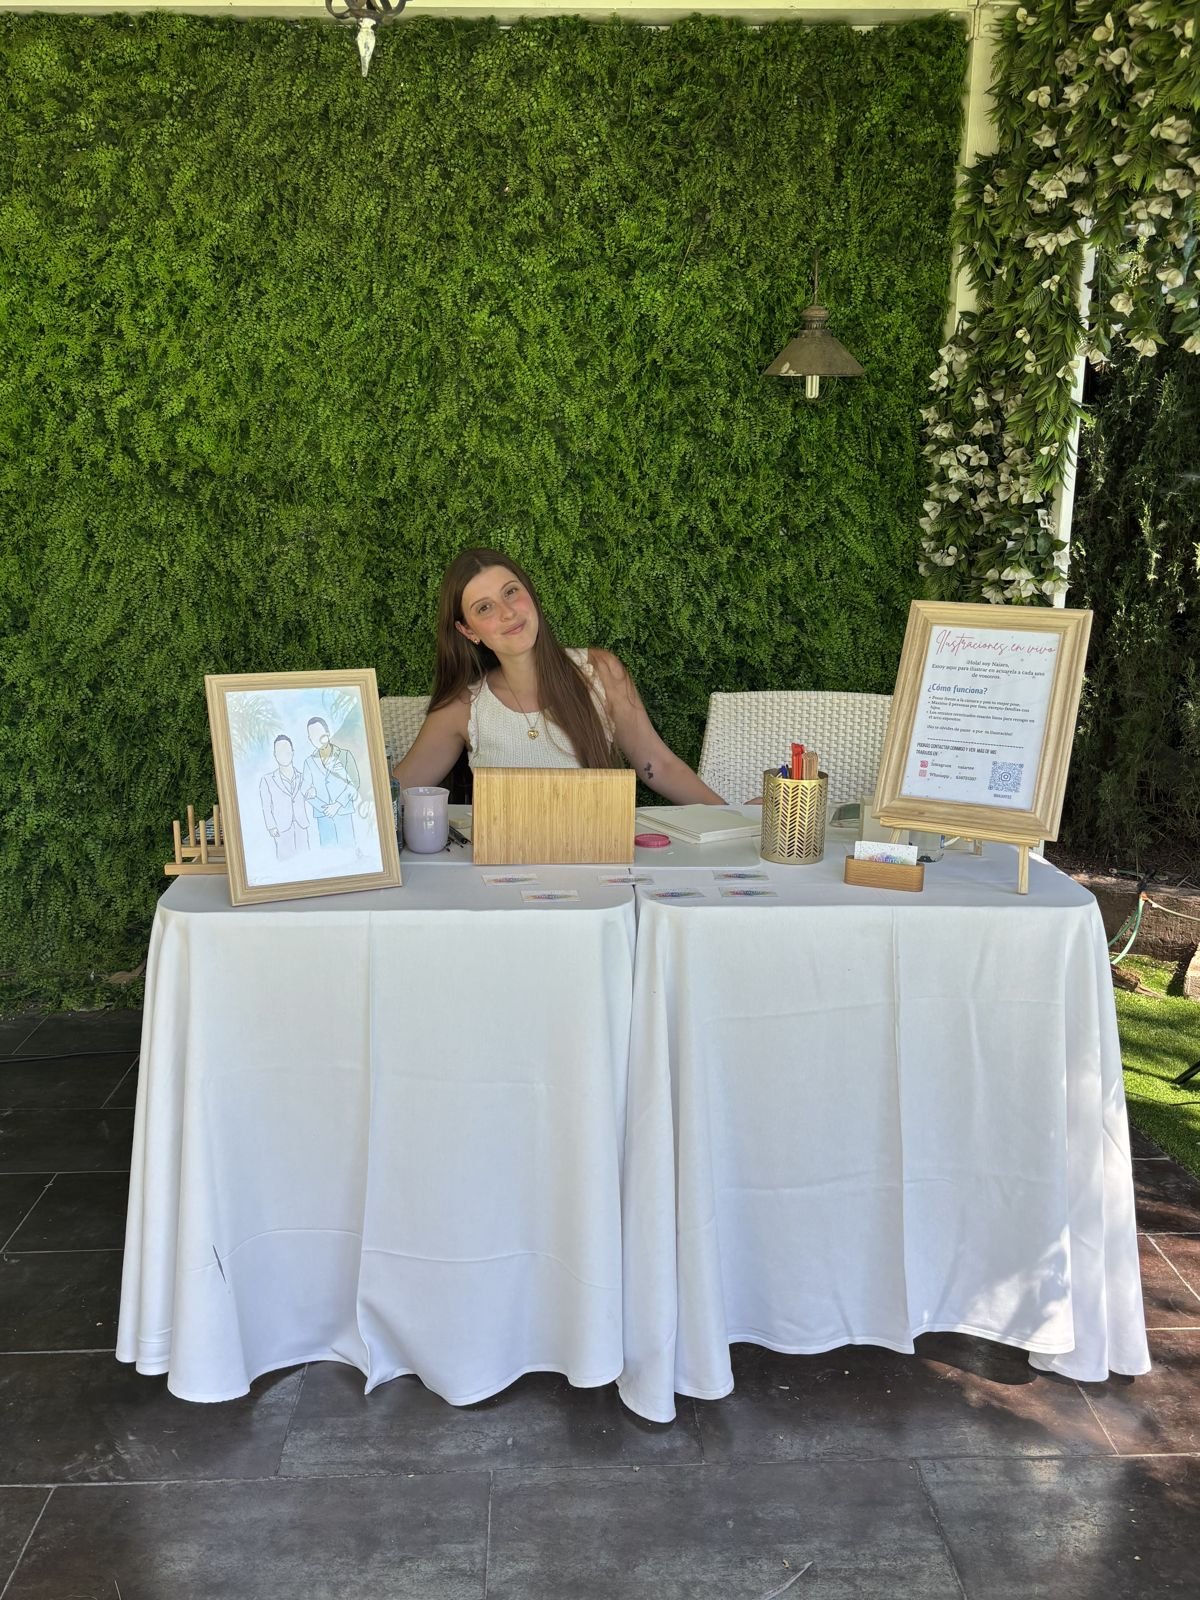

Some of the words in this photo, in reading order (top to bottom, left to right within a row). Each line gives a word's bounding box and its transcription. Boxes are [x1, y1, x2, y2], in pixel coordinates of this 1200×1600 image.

[936, 630, 1008, 656] Ilustraciones
[1008, 643, 1025, 652] en
[1027, 644, 1056, 655] vivo
[928, 682, 952, 693] ¿Cómo
[953, 685, 988, 696] funciona?
